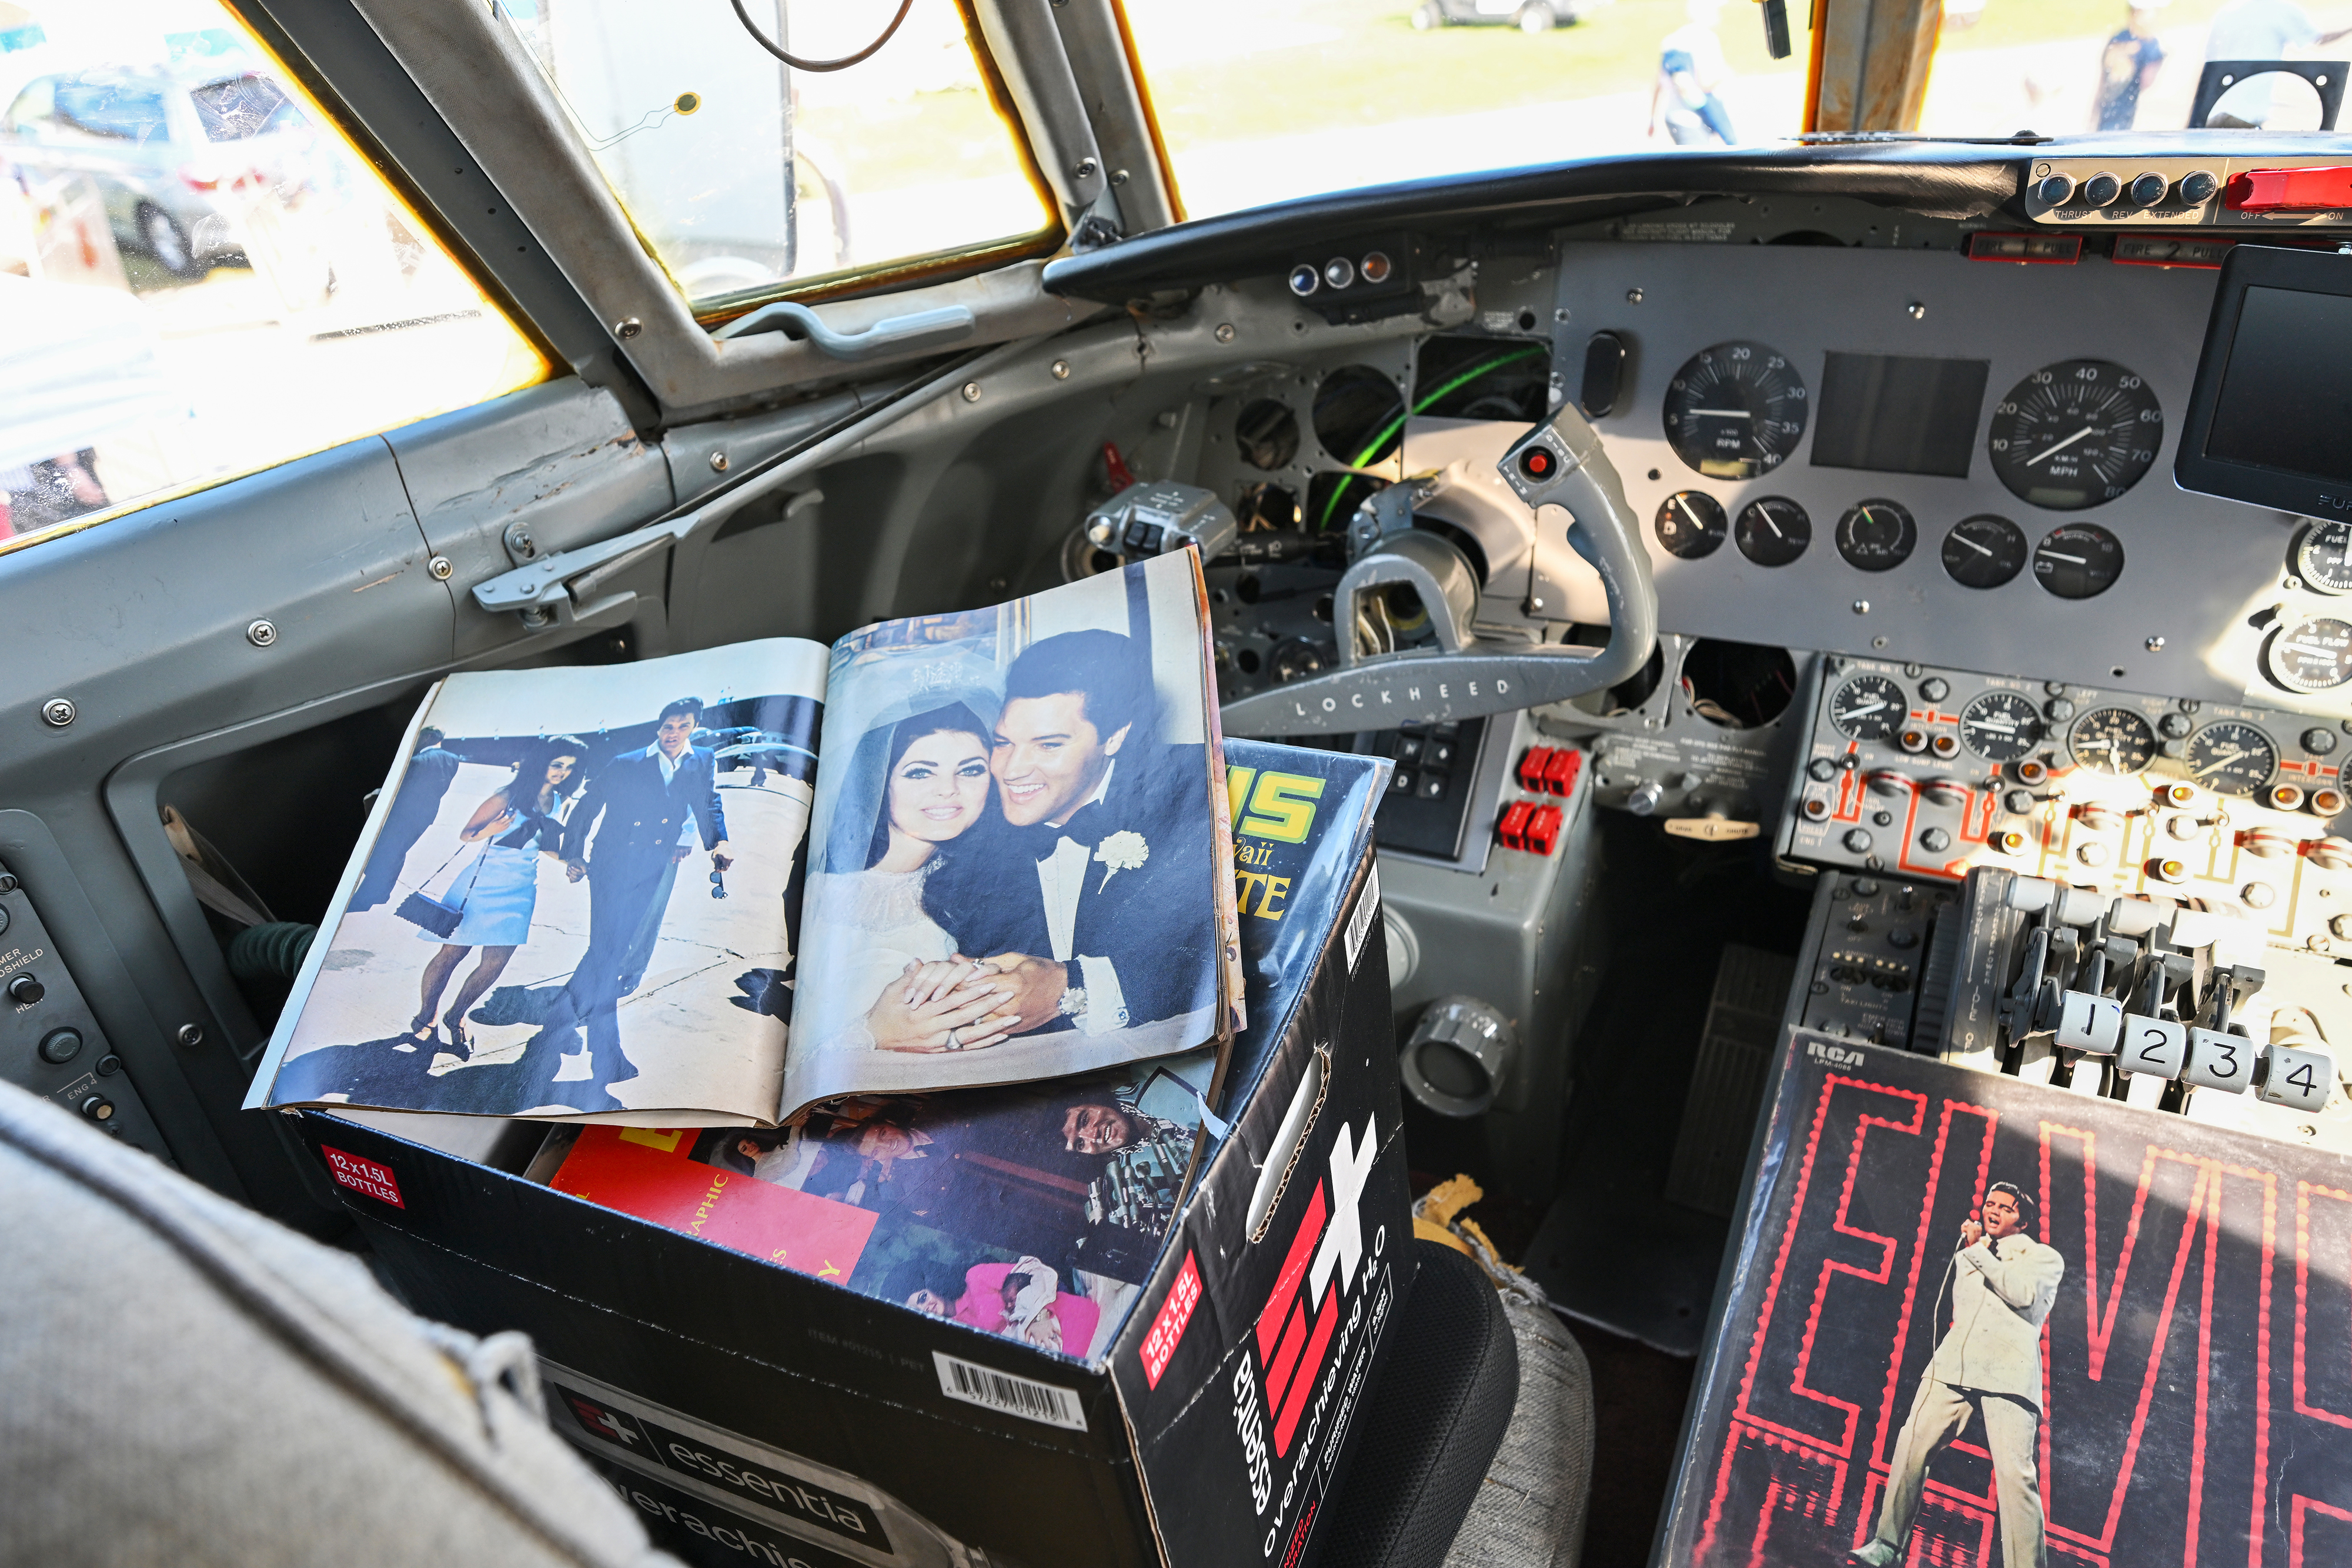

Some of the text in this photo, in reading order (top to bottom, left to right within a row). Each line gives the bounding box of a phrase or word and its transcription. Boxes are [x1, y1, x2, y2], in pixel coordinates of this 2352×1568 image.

[2055, 210, 2200, 220] THRUST REV EXTENDED
[2240, 212, 2344, 220] OFF ON
[2123, 242, 2152, 255] FIRE
[2164, 240, 2181, 261] 2
[1732, 347, 1750, 360] 20
[1767, 355, 1785, 370] 25
[2031, 371, 2053, 385] 30
[2075, 367, 2098, 382] 40
[2118, 375, 2141, 390] 50
[1787, 386, 1806, 400] 30
[1998, 402, 2017, 415] 20
[2139, 409, 2163, 423] 60
[1780, 421, 1799, 435] 35
[1715, 437, 1740, 450] RPM
[1993, 438, 2009, 452] 10
[1764, 452, 1782, 466] 40
[2131, 449, 2152, 463] 70
[2049, 465, 2079, 478] MPH
[1502, 465, 1528, 496] TRIM
[2296, 634, 2350, 647] FUEL FLOW
[1856, 660, 1876, 671] TANK
[1985, 677, 2006, 687] TANK
[1295, 679, 1511, 717] LOCKHEED
[2076, 689, 2099, 700] LEFT
[2213, 706, 2236, 717] TANK
[1910, 723, 1948, 733] INTERCONN
[1863, 753, 1875, 761] ON
[1895, 754, 1954, 770] LOW SUMP LEVEL
[2304, 752, 2324, 761] TANK
[2288, 774, 2334, 787] INTERCONN
[1983, 949, 1995, 985] POWER
[15, 998, 44, 1014] HE
[2081, 1002, 2096, 1037] 1
[2138, 1028, 2168, 1064] 2
[1807, 1041, 1865, 1067] RCA
[2207, 1042, 2239, 1079] 3
[2285, 1062, 2317, 1098] 4
[66, 1082, 90, 1101] ENG
[89, 1077, 98, 1088] 4
[330, 1154, 393, 1187] 12 x 1.5L
[336, 1171, 399, 1203] BOTTLES
[1146, 1271, 1194, 1359] 12 x 1.5L
[1151, 1282, 1198, 1379] BOTTLES
[1324, 1346, 1366, 1463] PURIFIED WATER
[1232, 1350, 1272, 1516] essentia
[1264, 1295, 1362, 1558] overachieving
[668, 1442, 867, 1534] essentia
